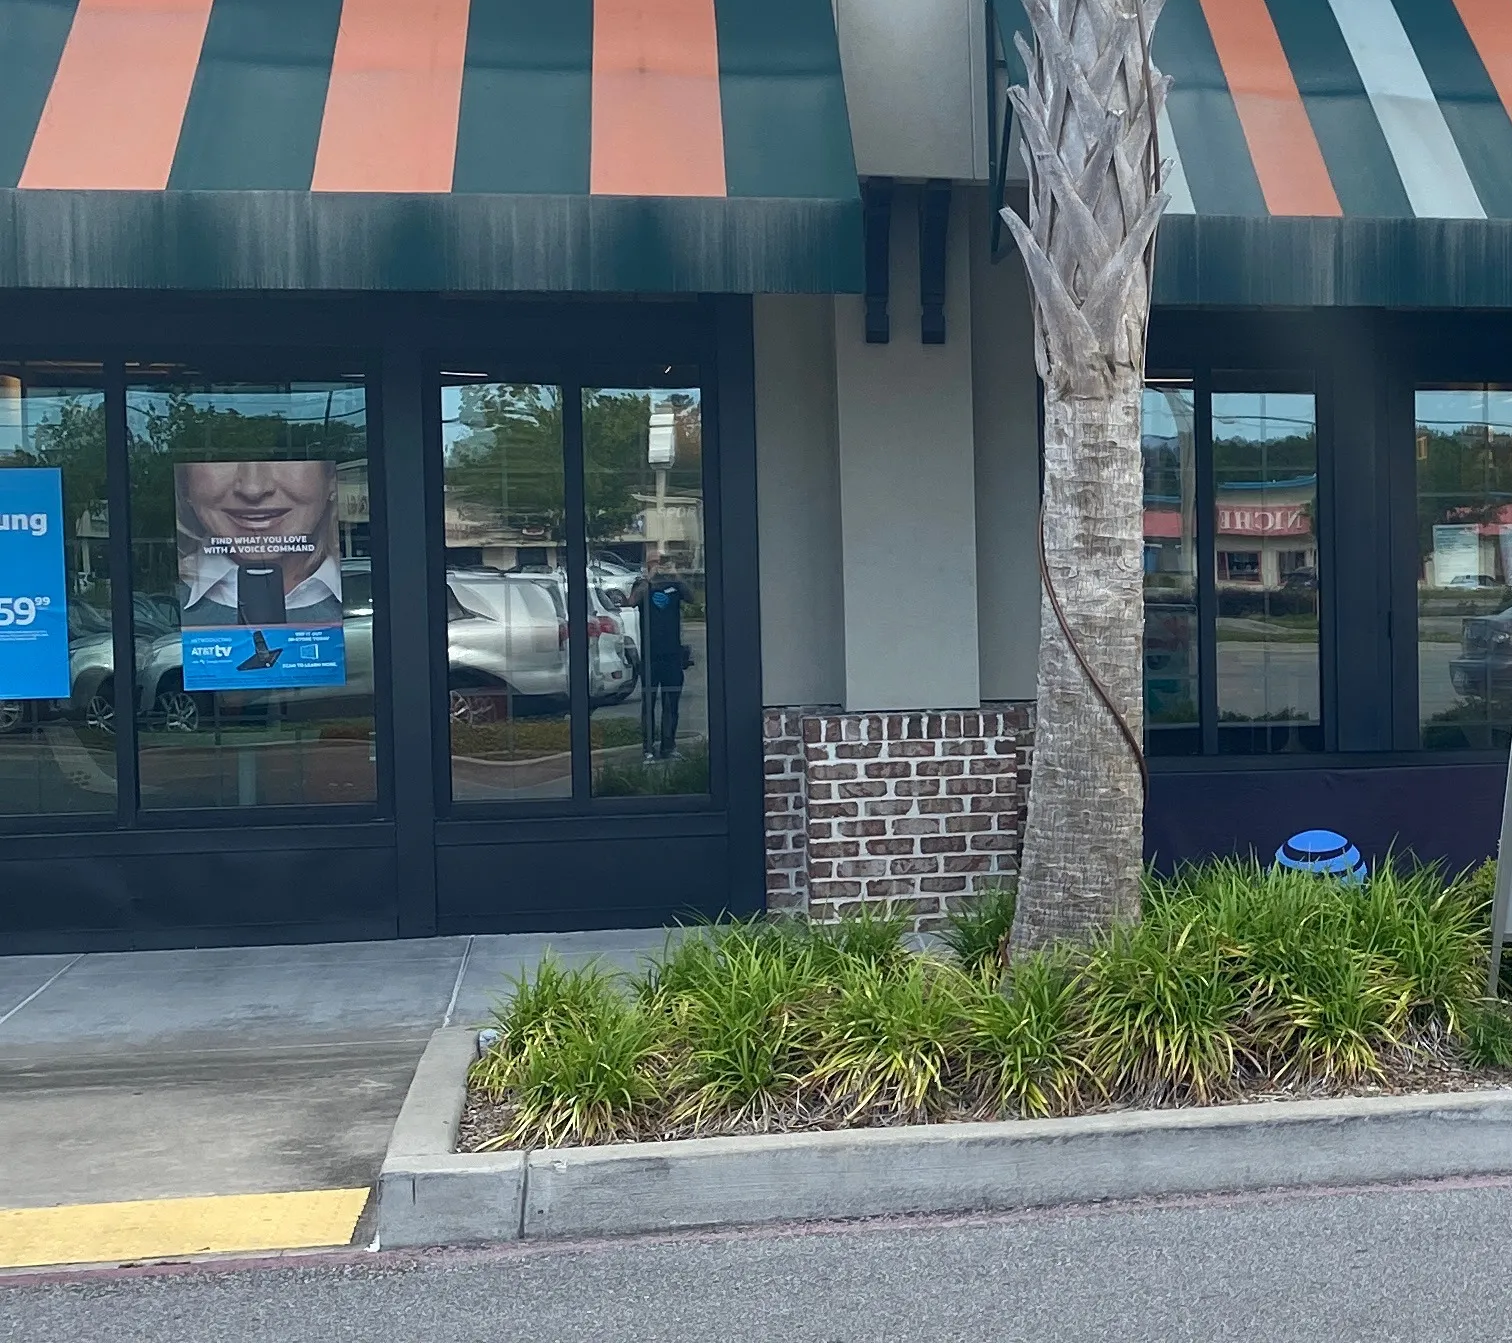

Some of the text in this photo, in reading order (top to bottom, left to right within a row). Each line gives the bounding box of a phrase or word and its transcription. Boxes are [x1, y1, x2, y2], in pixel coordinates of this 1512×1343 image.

[210, 535, 307, 545] FIND WHAT YOU LOVE
[203, 544, 315, 554] WITH A VOICE COMMAND
[191, 644, 233, 657] AT&T tv
